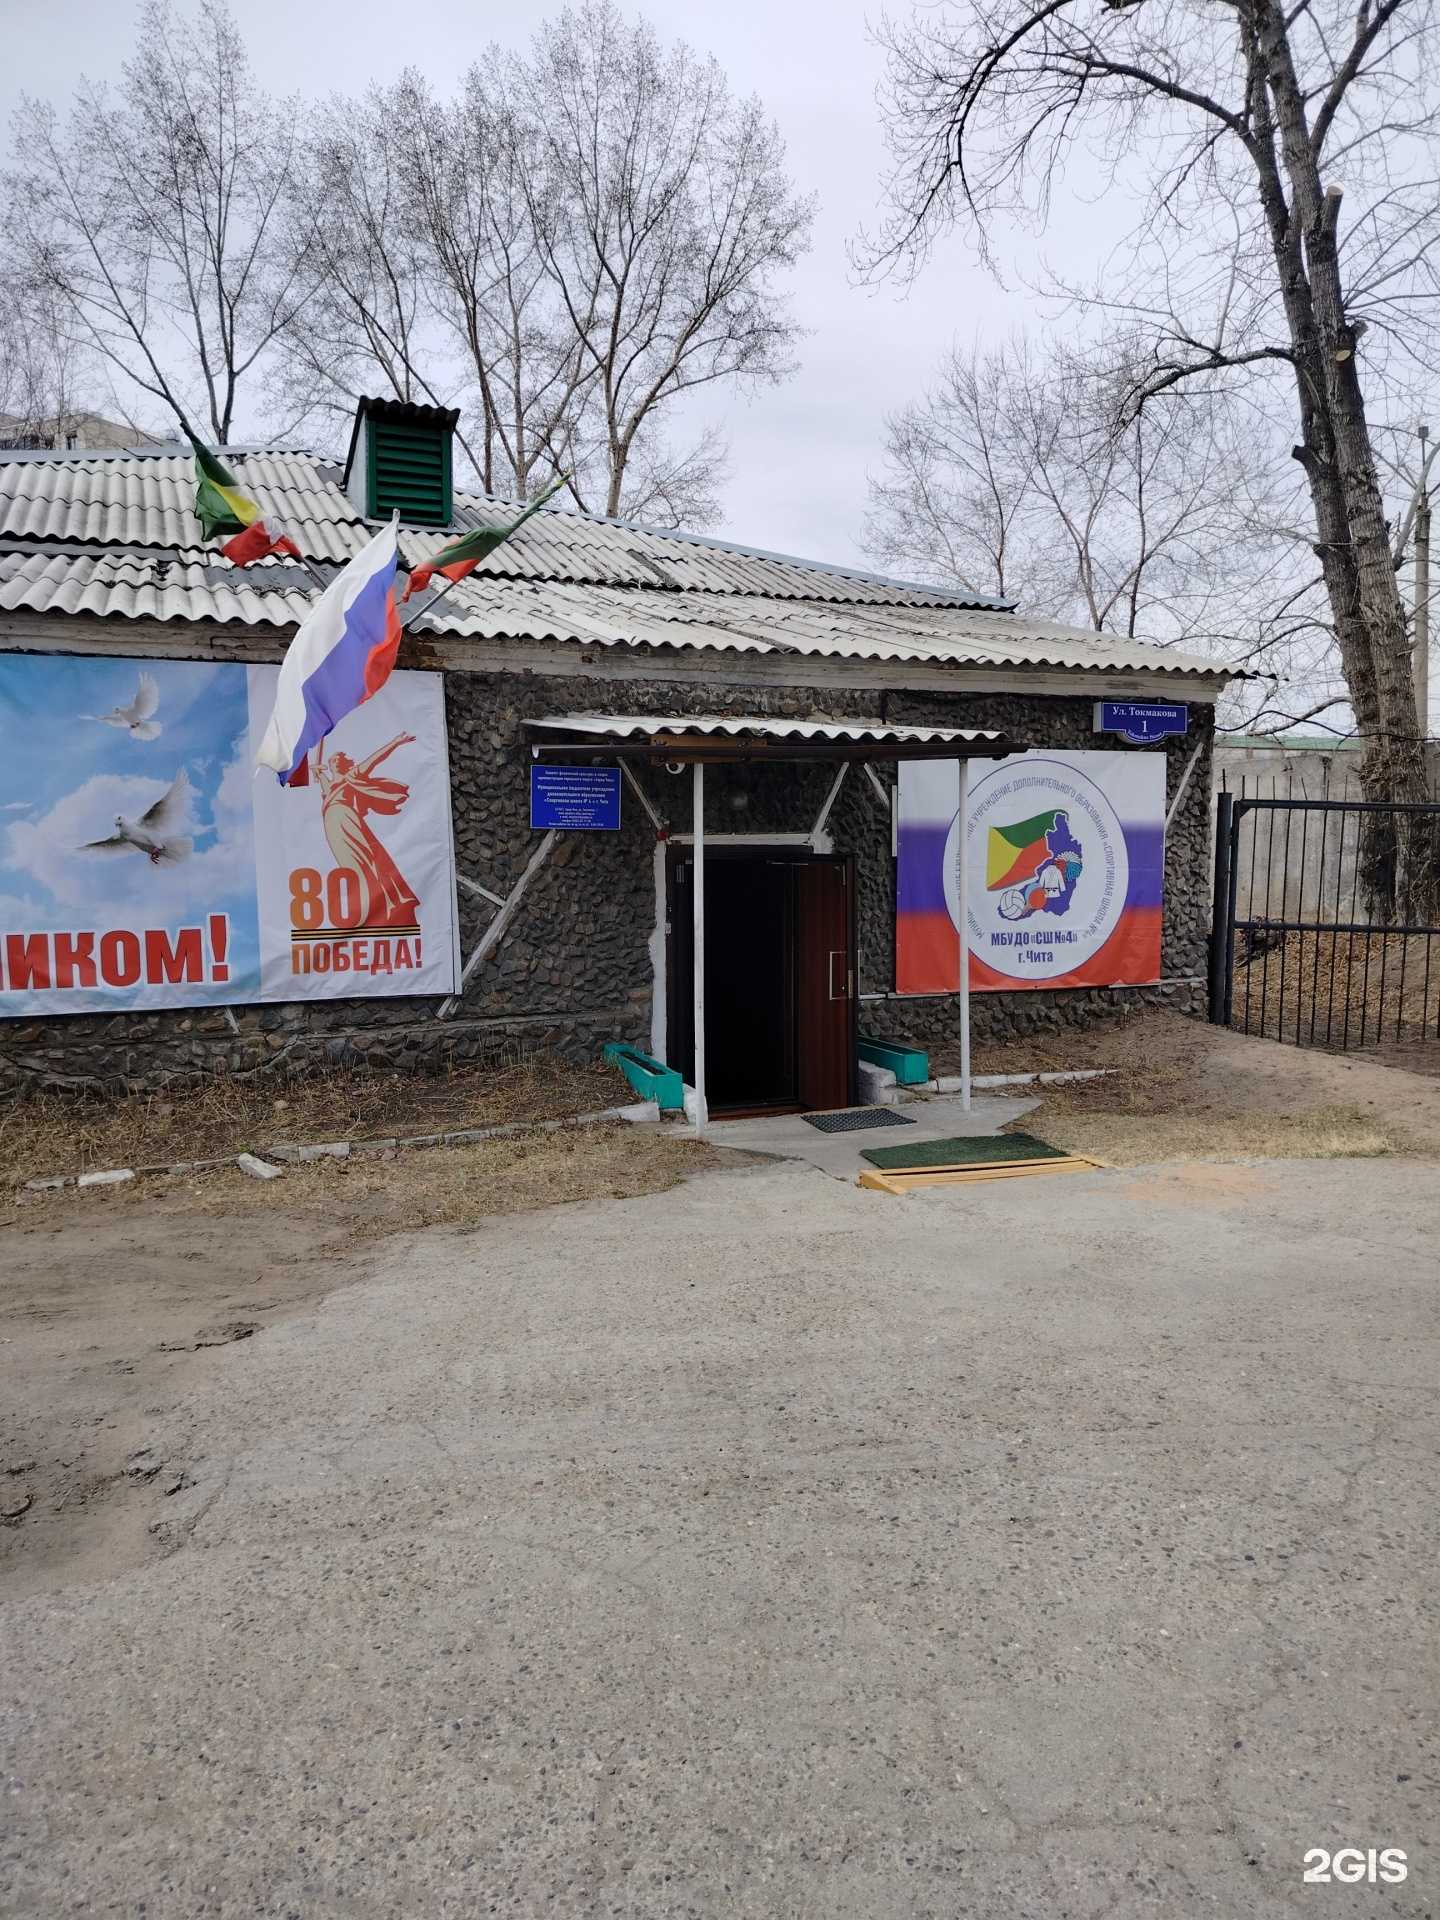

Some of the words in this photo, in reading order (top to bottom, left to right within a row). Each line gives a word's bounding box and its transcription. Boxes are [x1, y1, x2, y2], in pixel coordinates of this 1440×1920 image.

[1112, 706, 1127, 716] Ул.
[1129, 706, 1177, 718] Токмакова
[1141, 720, 1149, 733] 1
[289, 867, 364, 930] 80
[0, 913, 230, 991] ИКОМ!
[991, 931, 1030, 947] МБУДО
[291, 938, 424, 976] ПОБЕДА!
